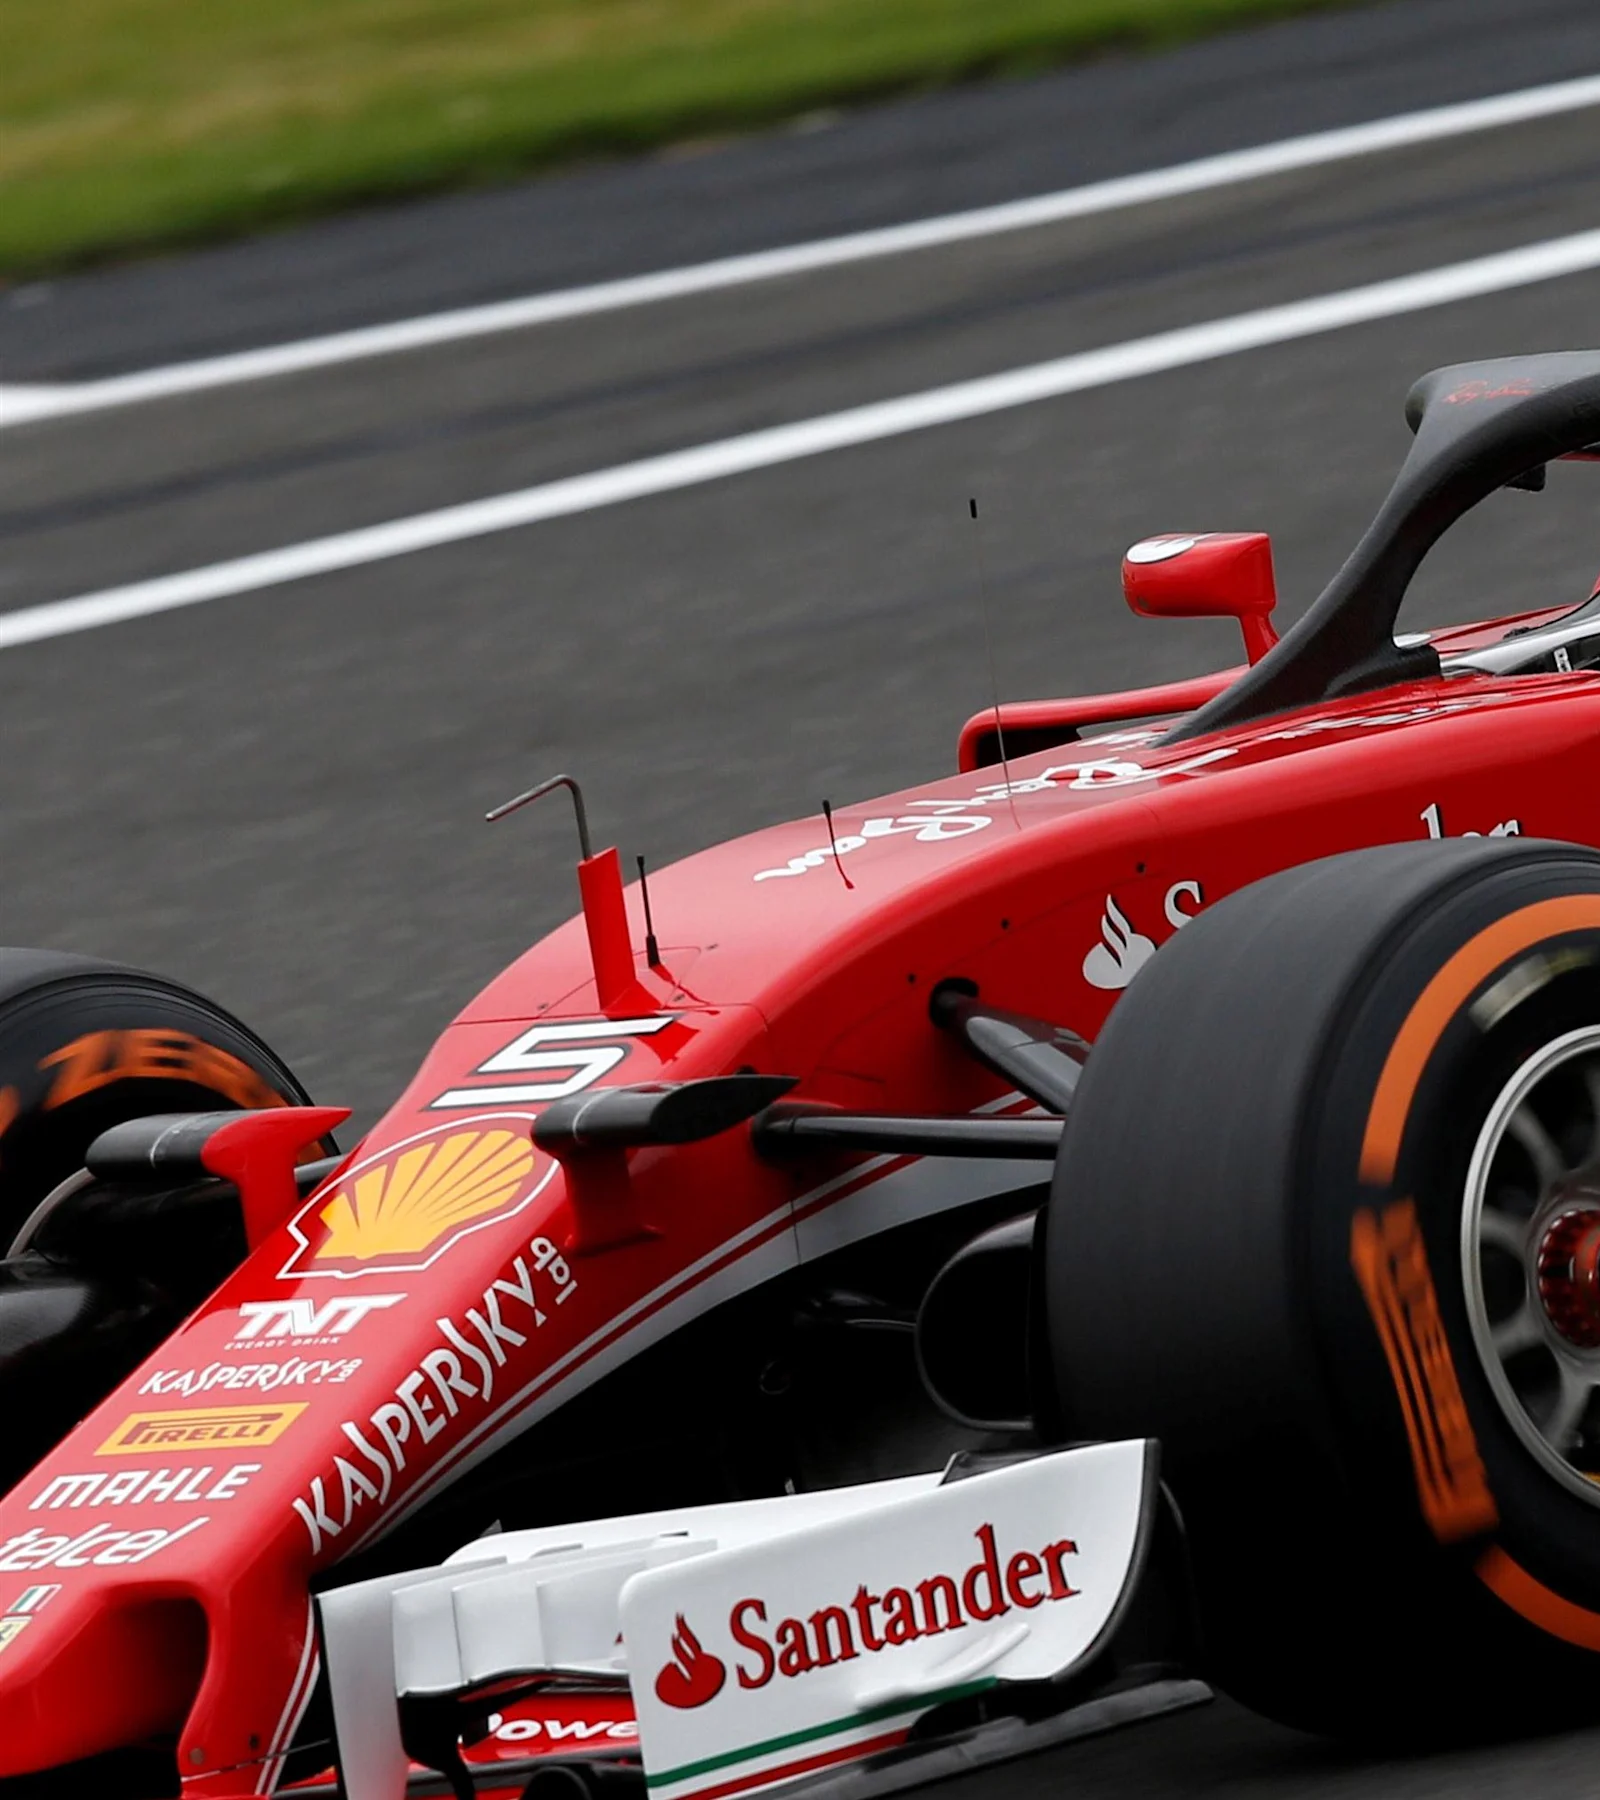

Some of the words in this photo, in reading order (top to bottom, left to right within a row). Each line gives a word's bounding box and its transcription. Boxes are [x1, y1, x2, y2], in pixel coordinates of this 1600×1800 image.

[424, 1013, 680, 1110] 5
[233, 1292, 409, 1340] TNT
[223, 1338, 287, 1351] ENERGY
[291, 1336, 341, 1347] DRINK
[138, 1357, 341, 1398] KASPERSKY
[116, 1411, 285, 1447] PIRELLI
[291, 1255, 548, 1556] KASPERSKY
[27, 1463, 263, 1510] MAHLE
[0, 1516, 211, 1572] telcel
[729, 1523, 1081, 1690] Santander
